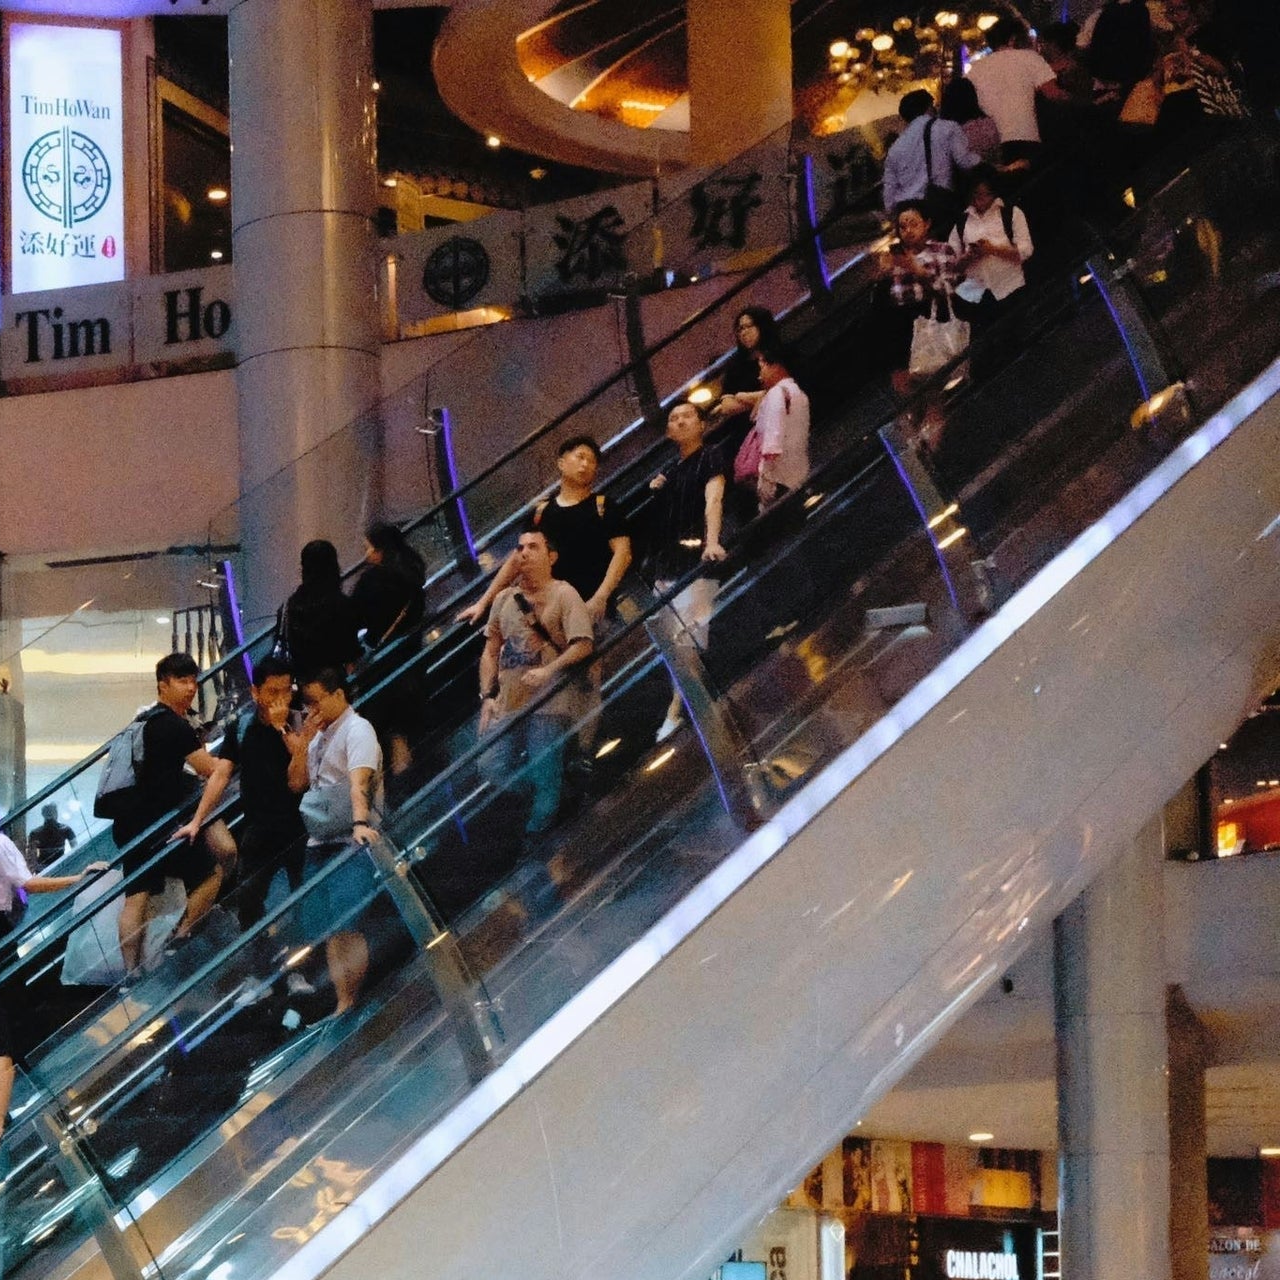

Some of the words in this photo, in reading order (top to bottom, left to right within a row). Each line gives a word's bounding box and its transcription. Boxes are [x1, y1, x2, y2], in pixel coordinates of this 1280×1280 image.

[21, 95, 111, 120] TimHoWan
[15, 306, 112, 364] Tim
[164, 286, 232, 345] Ho
[946, 1249, 1020, 1280] CHALACHOL
